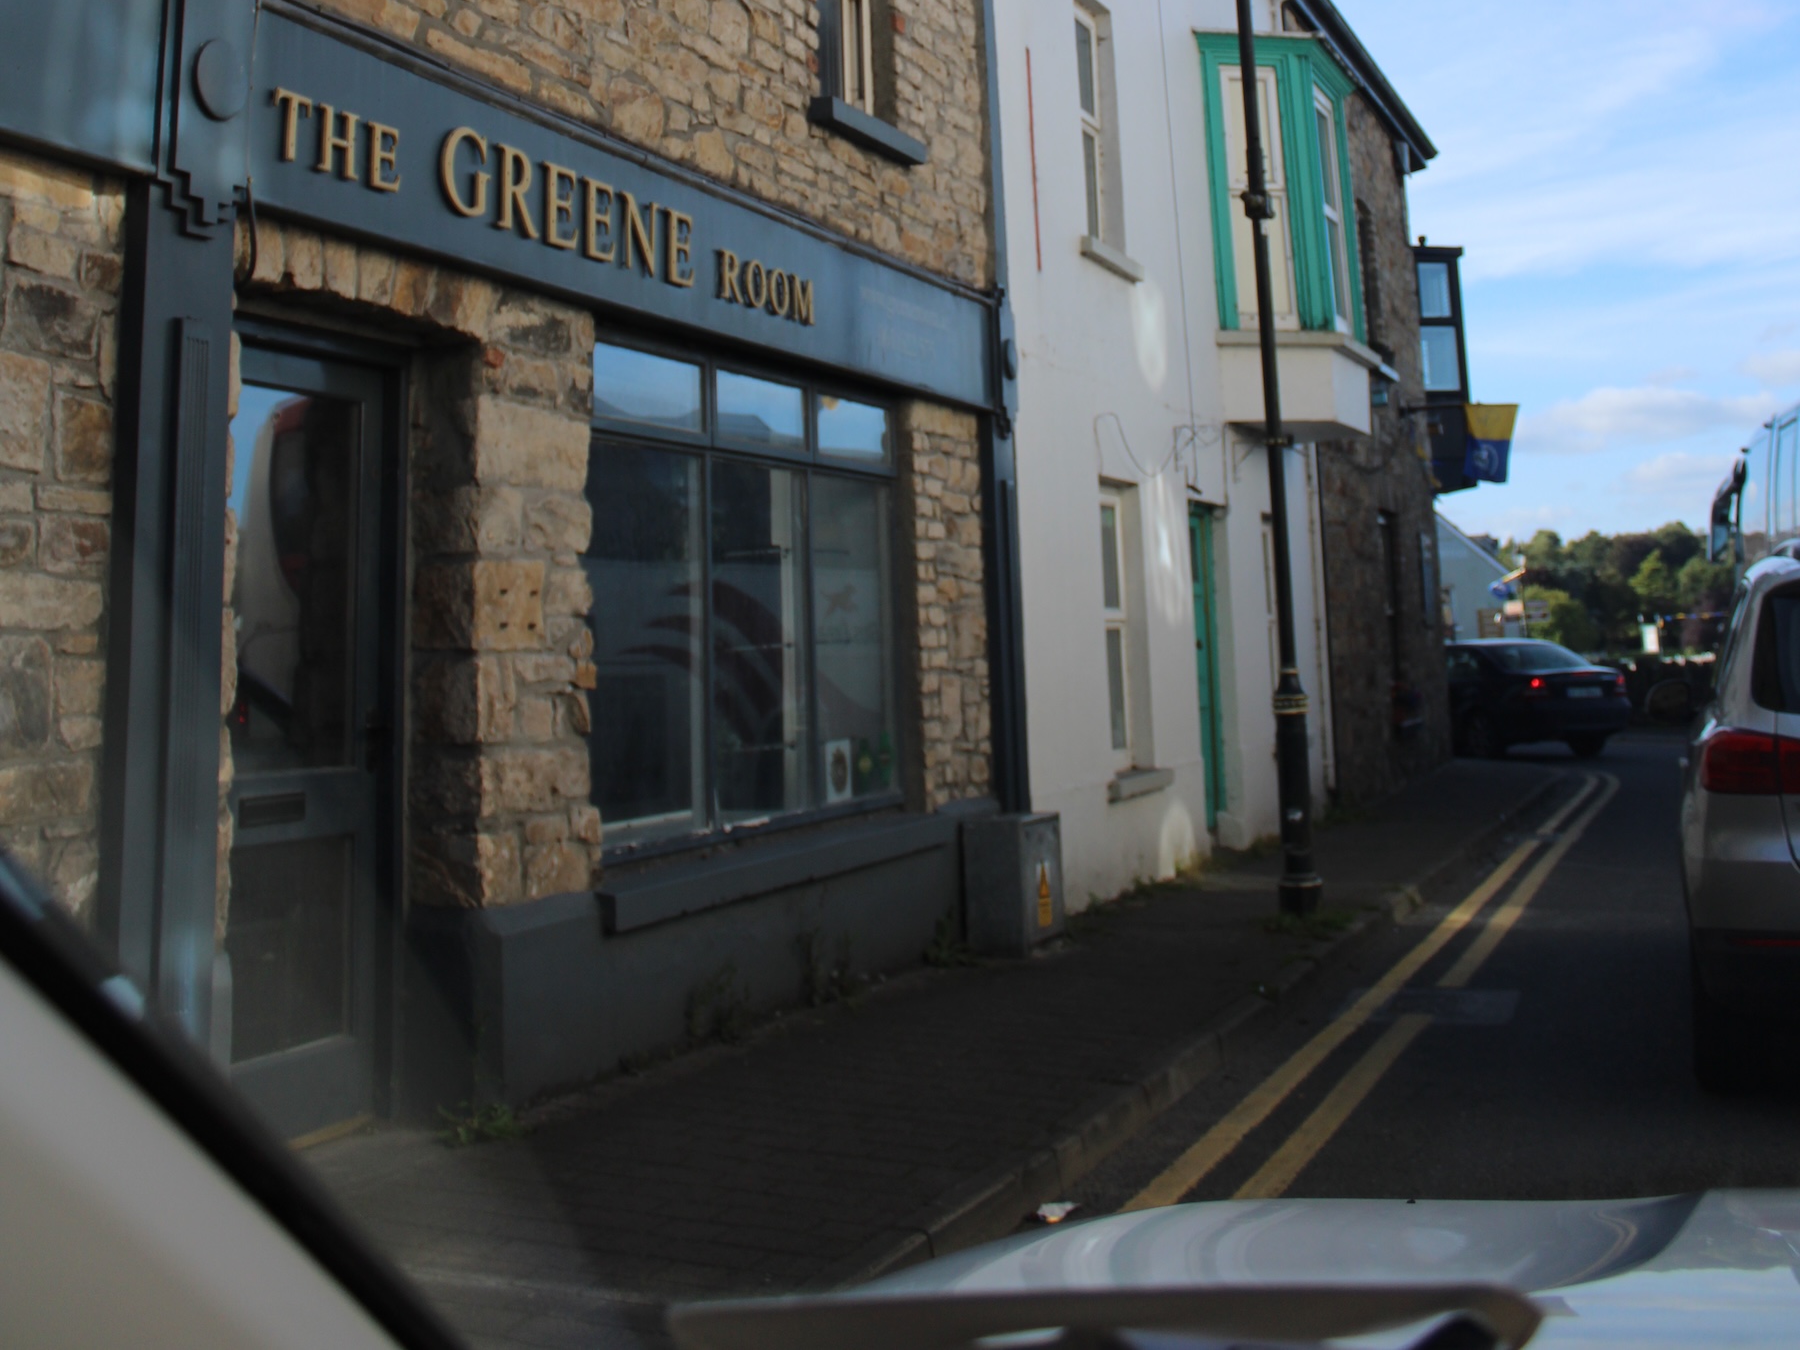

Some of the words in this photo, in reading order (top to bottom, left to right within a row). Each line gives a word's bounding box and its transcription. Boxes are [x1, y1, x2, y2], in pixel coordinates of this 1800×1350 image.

[273, 86, 401, 192] THE
[440, 126, 695, 288] GREENE
[717, 248, 815, 327] ROOM
